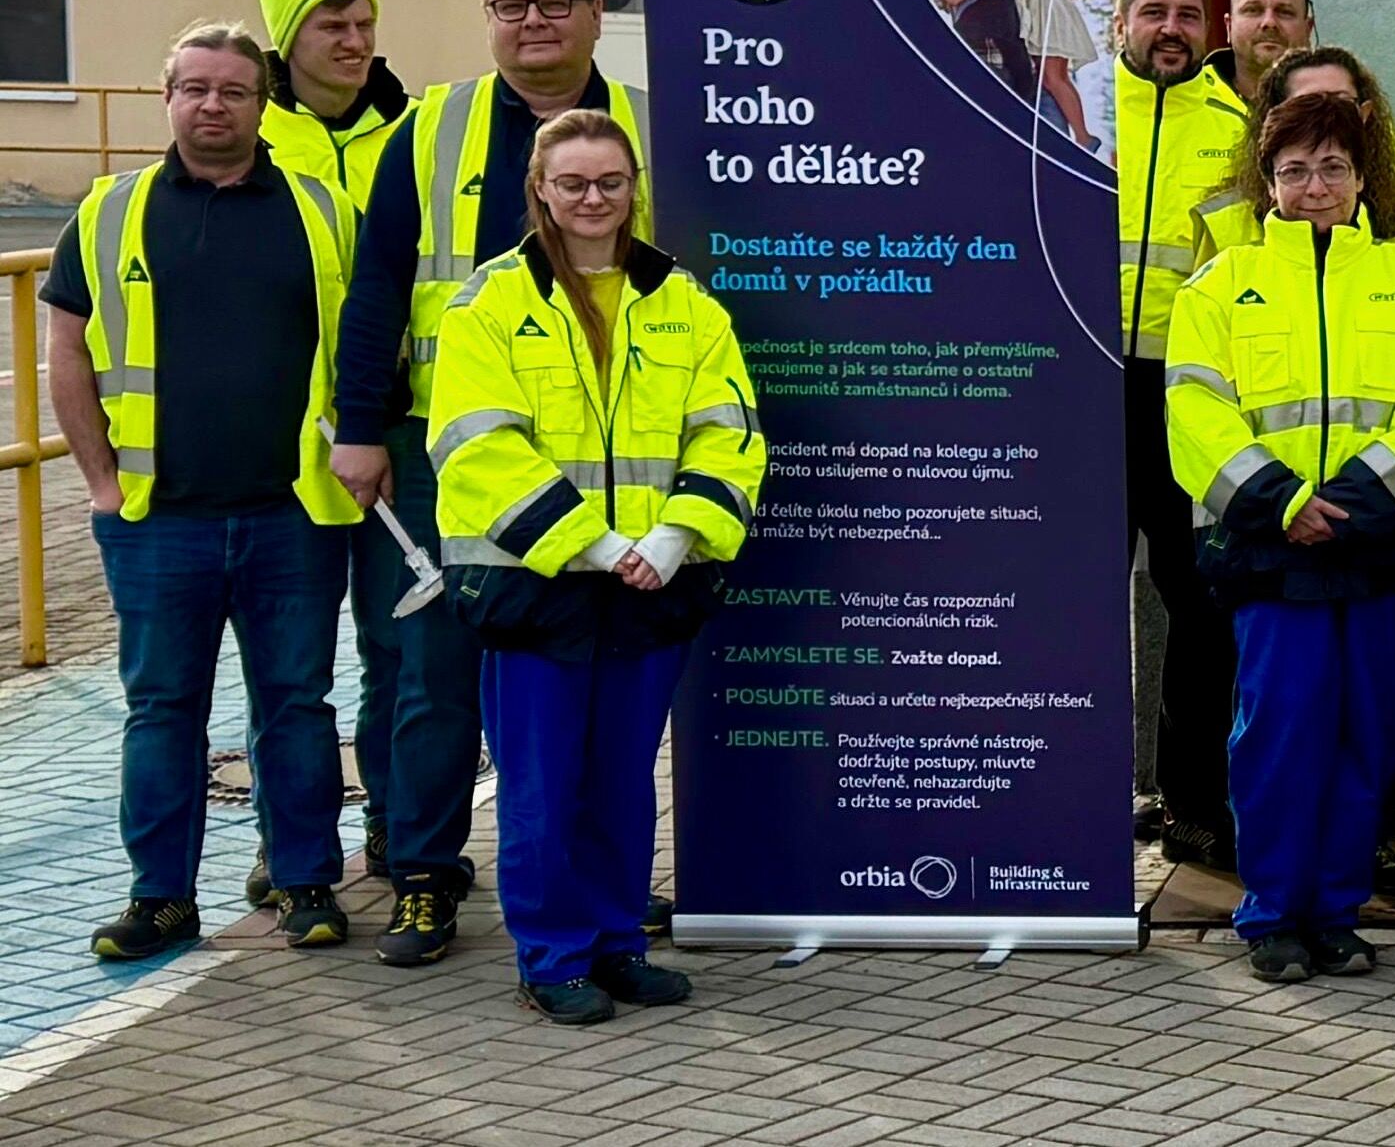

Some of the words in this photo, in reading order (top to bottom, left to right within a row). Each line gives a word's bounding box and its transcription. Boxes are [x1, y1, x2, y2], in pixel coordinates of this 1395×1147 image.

[703, 28, 783, 66] Pro
[704, 84, 814, 125] koho
[706, 149, 753, 182] to
[768, 144, 925, 185] děláte?
[710, 232, 834, 257] Dostaňte
[842, 240, 871, 257] se
[878, 234, 959, 266] každý
[967, 236, 1016, 259] den
[711, 266, 787, 291] domů
[794, 275, 812, 291] v
[819, 268, 932, 299] pořádku
[724, 588, 837, 605] ZASTAVTE.
[840, 592, 899, 610] Věnujte
[903, 593, 929, 607] čas
[934, 592, 1015, 610] rozpoznání
[724, 646, 847, 663] ZAMYSLETE
[854, 648, 884, 664] SE.
[891, 650, 943, 665] Zvažte
[947, 651, 1001, 668] dopad.
[726, 685, 825, 705] POSUĎTE
[726, 730, 829, 747] JEDNEJTE.
[840, 866, 906, 887] orbia
[990, 865, 1050, 880] Building
[1053, 866, 1064, 878] &
[990, 878, 1090, 890] Infrastructure
